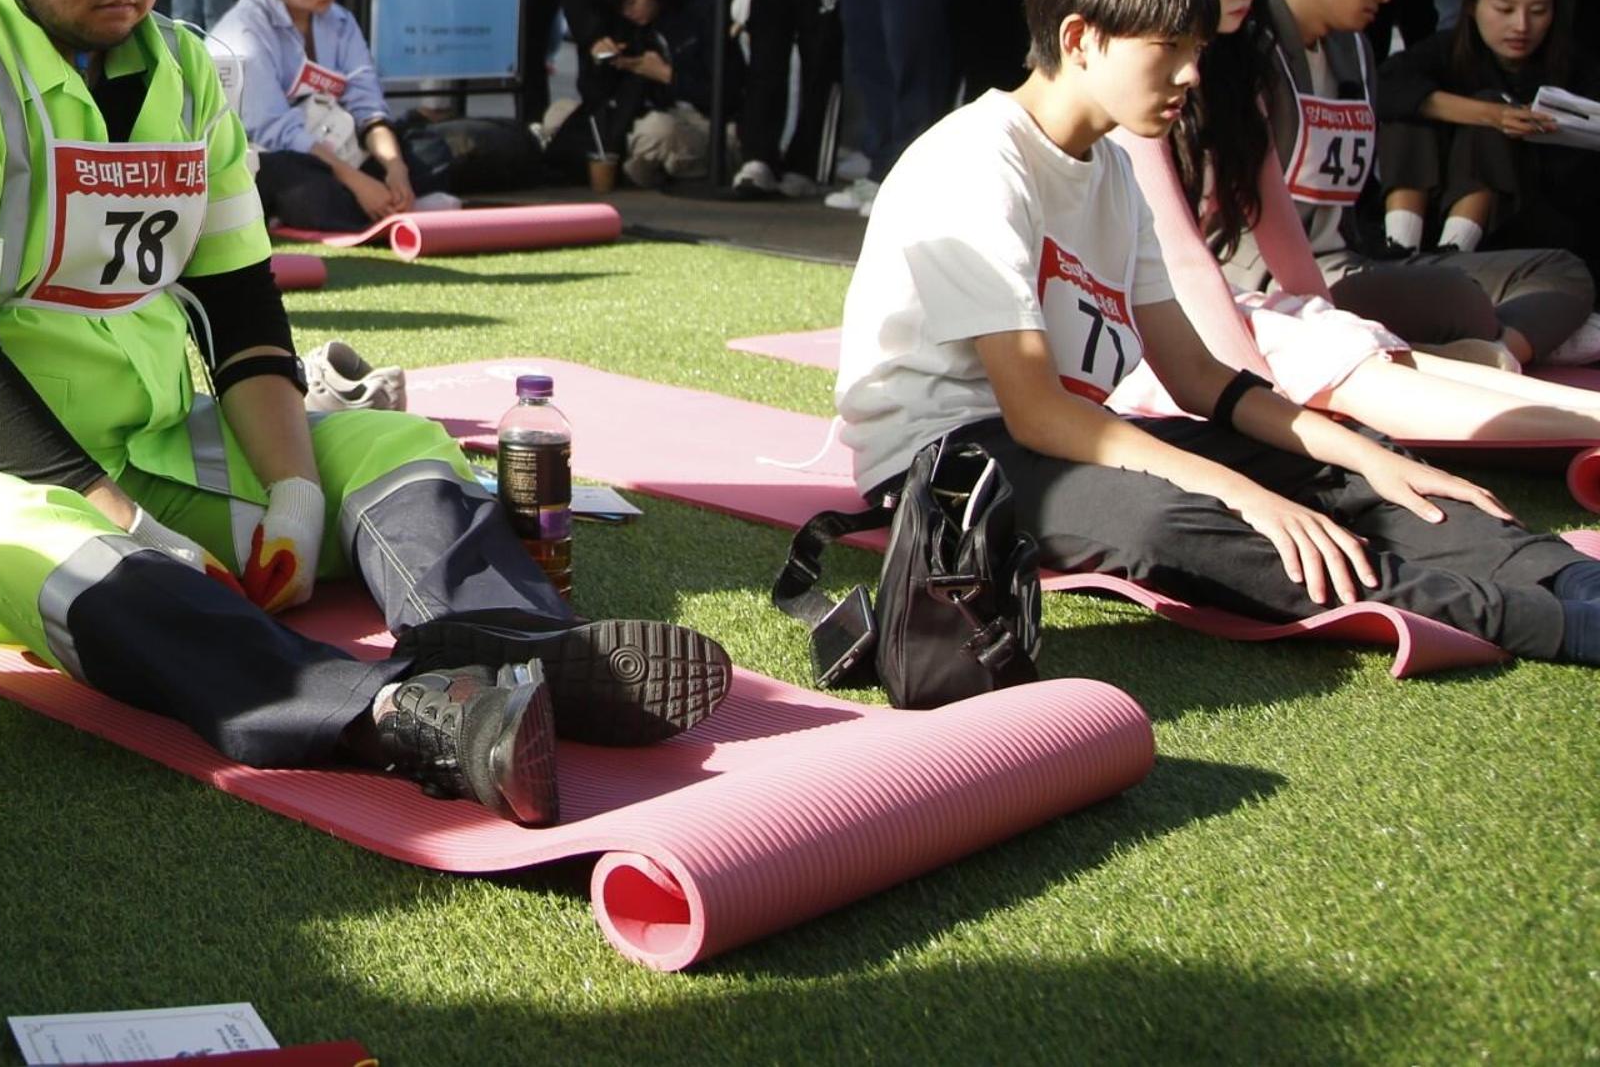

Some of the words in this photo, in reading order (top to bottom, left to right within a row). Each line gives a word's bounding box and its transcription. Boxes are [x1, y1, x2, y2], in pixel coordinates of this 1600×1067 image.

[75, 159, 166, 189] 멍때리기
[1318, 136, 1367, 187] 45
[100, 210, 179, 285] 78
